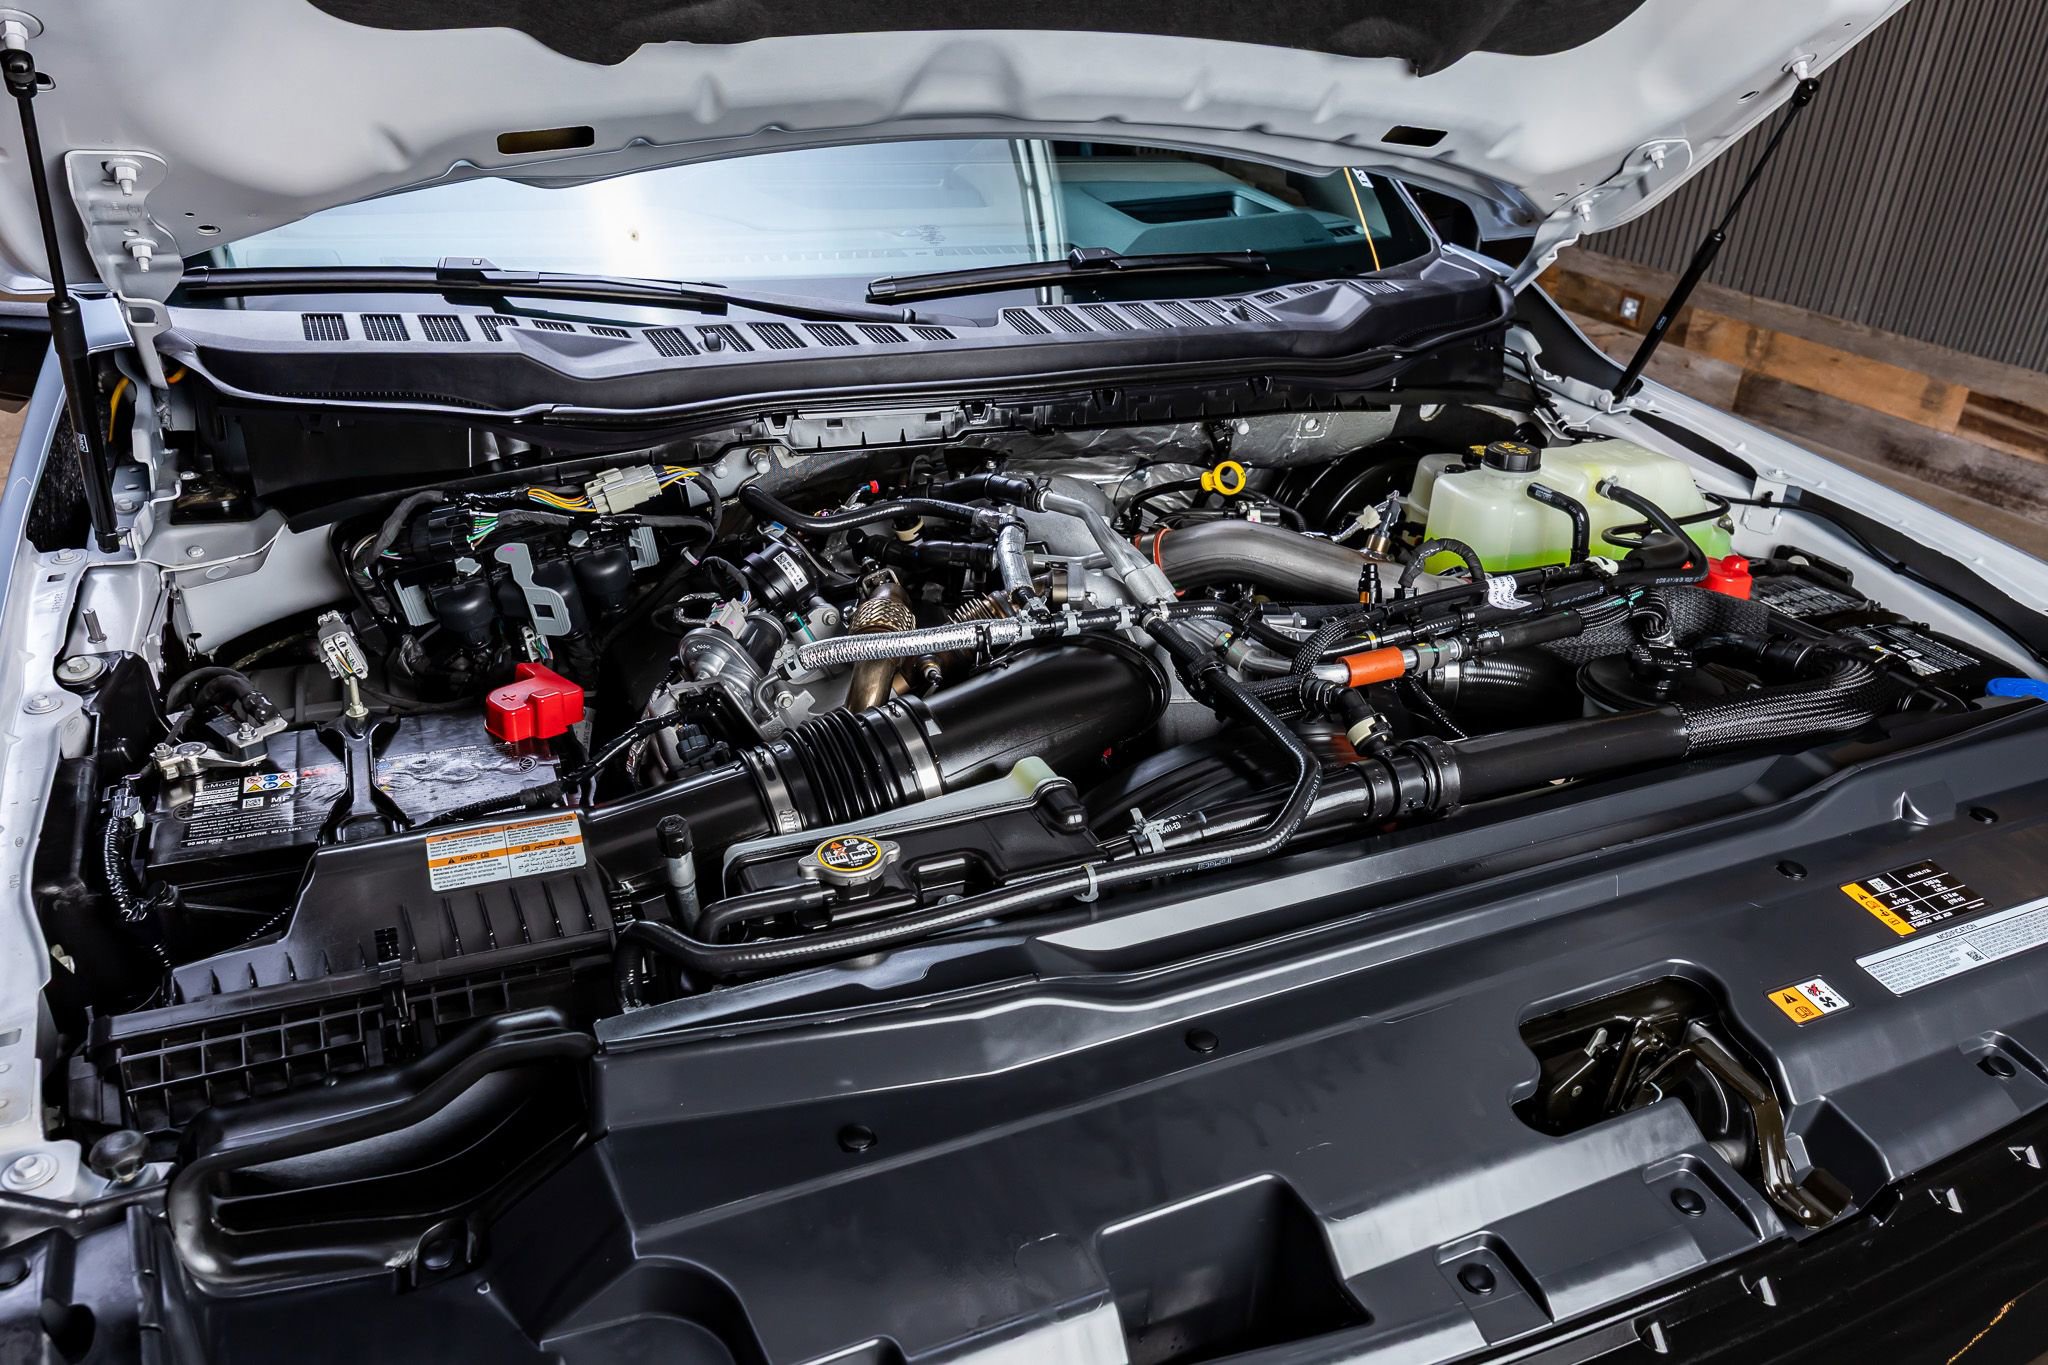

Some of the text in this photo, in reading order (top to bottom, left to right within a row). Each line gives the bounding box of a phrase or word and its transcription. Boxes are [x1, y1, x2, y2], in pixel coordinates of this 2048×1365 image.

[197, 780, 239, 791] oMoCo
[271, 795, 291, 803] MF
[1936, 923, 1977, 940] MODIFICATION
